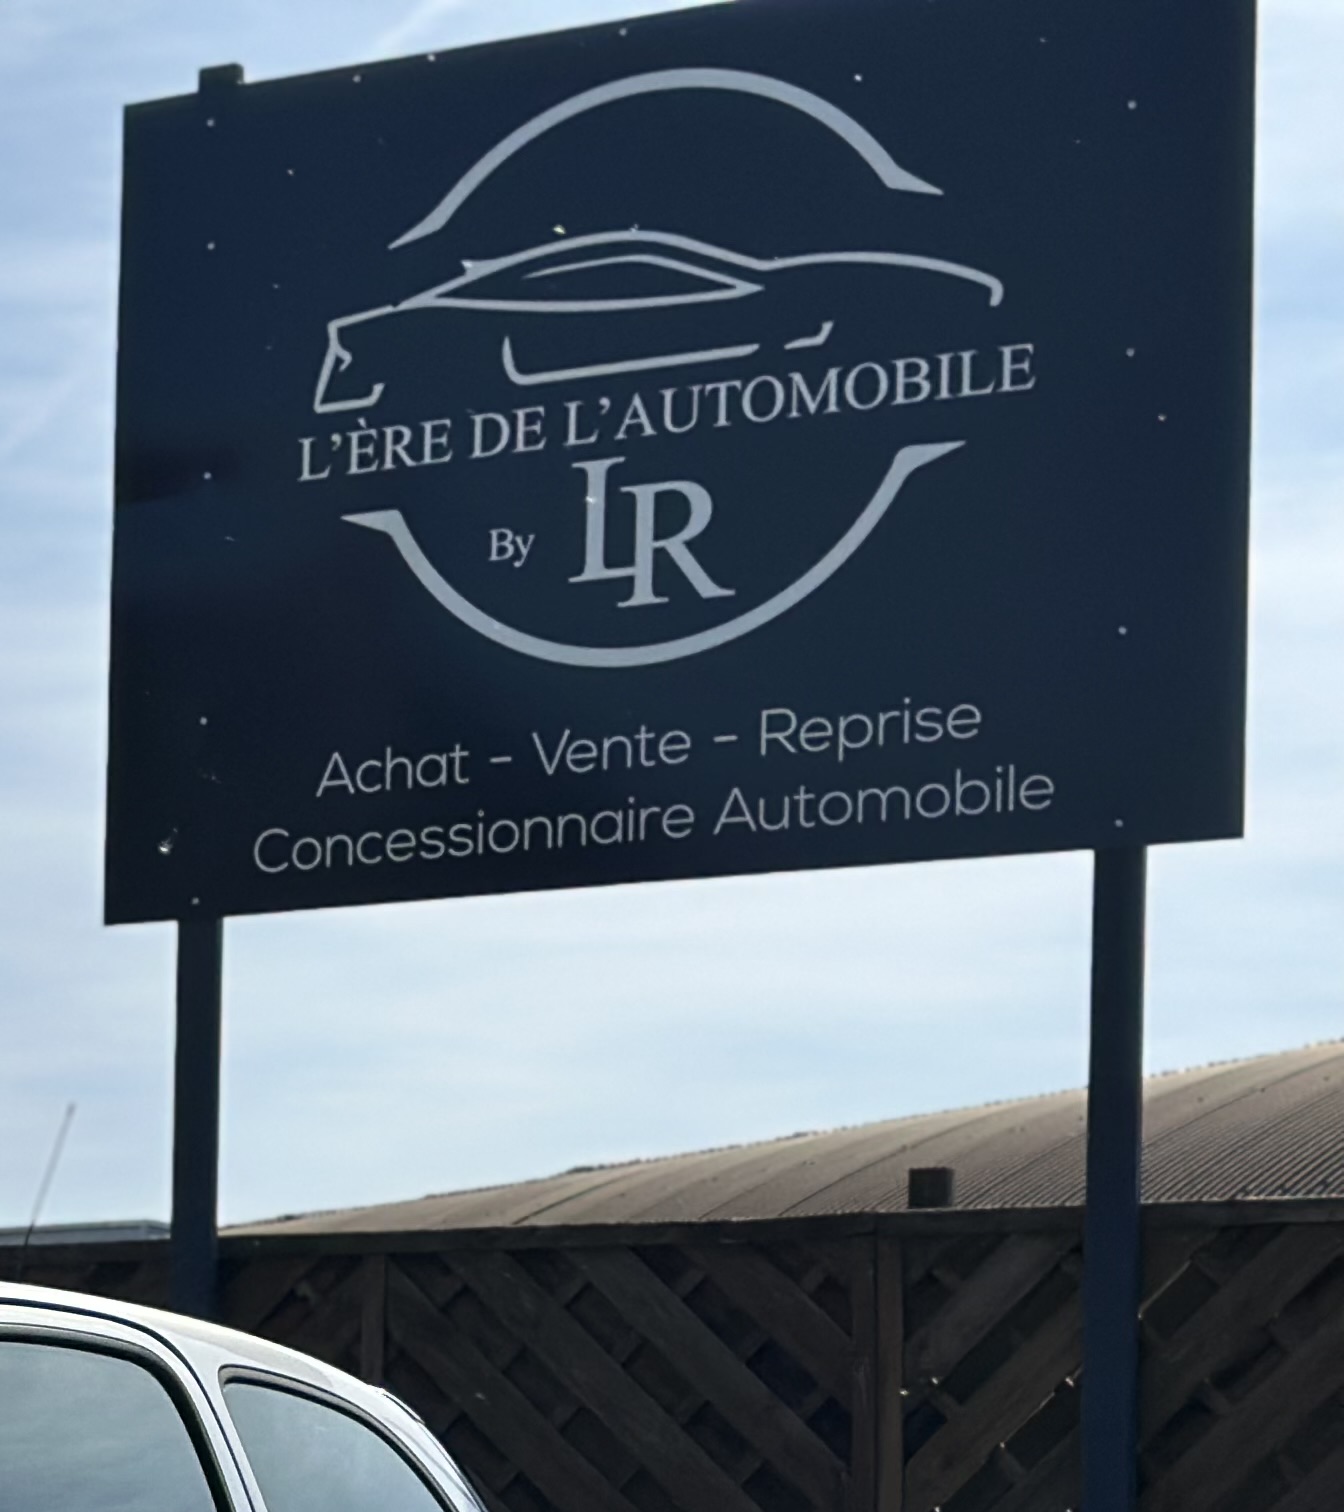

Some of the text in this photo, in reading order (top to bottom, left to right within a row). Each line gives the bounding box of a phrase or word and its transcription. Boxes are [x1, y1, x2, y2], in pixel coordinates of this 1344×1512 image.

[298, 342, 1037, 482] L'ÈRE DE L'AUTOMOBILE
[489, 456, 736, 608] By LR
[315, 742, 470, 798] Achat
[532, 722, 691, 776] Vente
[760, 697, 983, 763] Reprise
[252, 763, 1056, 874] Concessionnaire Automobile
